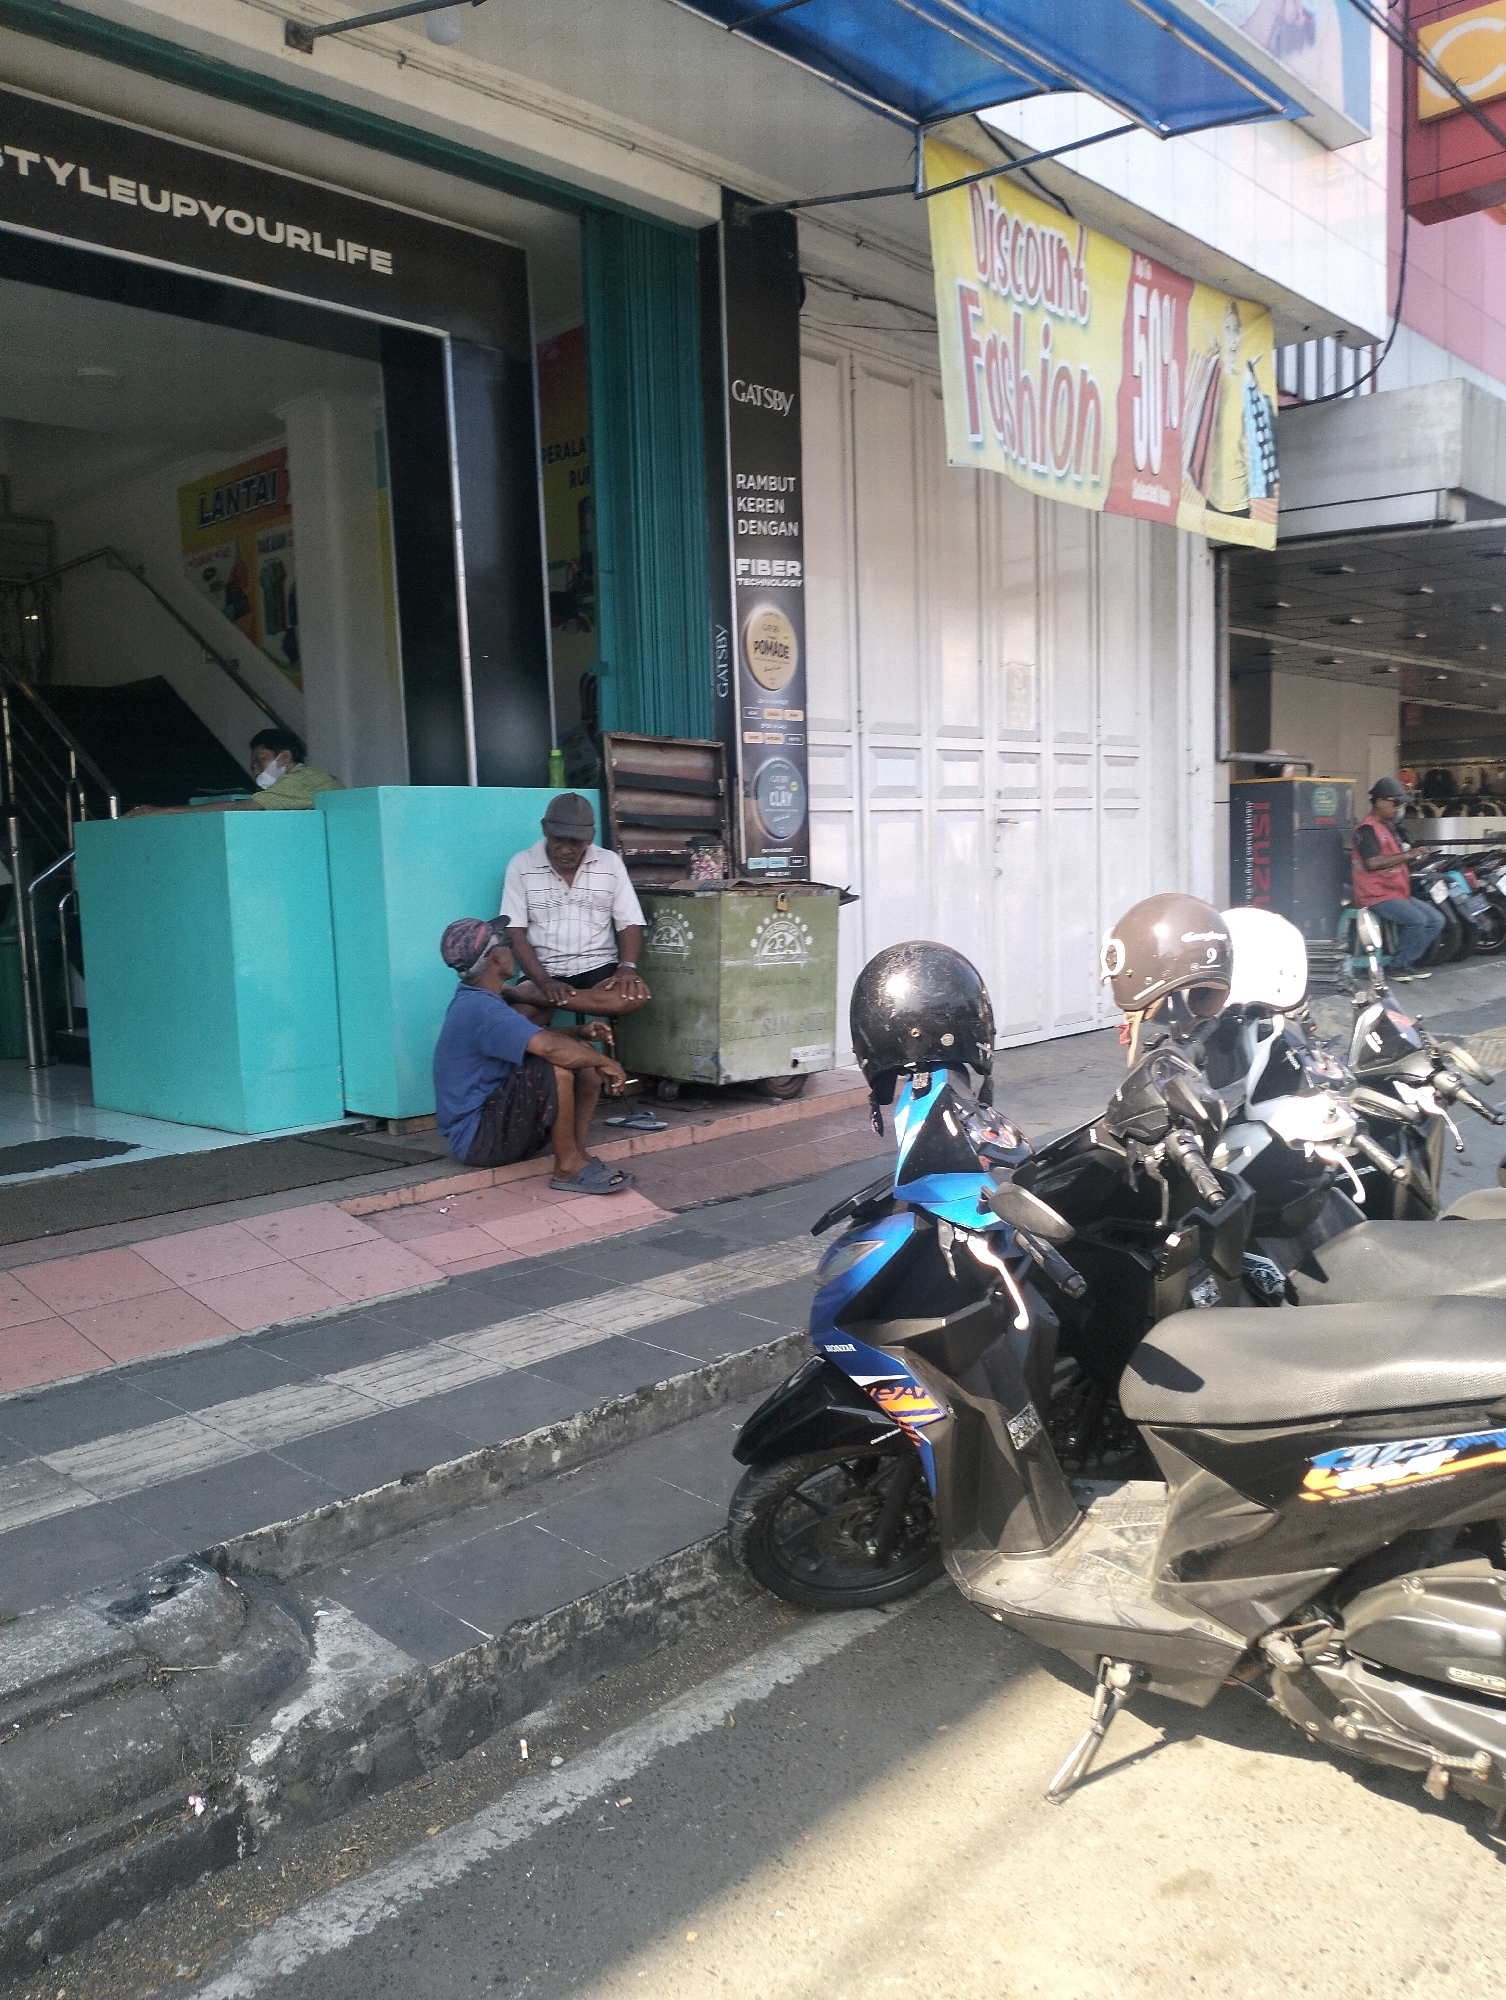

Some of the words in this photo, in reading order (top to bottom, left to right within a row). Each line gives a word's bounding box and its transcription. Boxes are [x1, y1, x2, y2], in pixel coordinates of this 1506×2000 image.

[0, 145, 393, 275] TYLEUPYOURLIFE
[966, 176, 1090, 325] Discount
[955, 277, 1102, 483] Fashion
[1132, 283, 1180, 476] 50%
[732, 379, 794, 417] GATSBY
[736, 473, 796, 492] RAMBUT
[198, 467, 278, 529] LANTAI
[736, 497, 786, 514] KEREN
[737, 519, 799, 537] DENGAN
[736, 558, 802, 577] FIBER
[736, 577, 803, 588] TECHNOLOGY
[753, 639, 791, 659] POMADE
[714, 624, 730, 698] GATSBY
[768, 790, 793, 807] CLAY
[823, 1343, 857, 1353] HONDA
